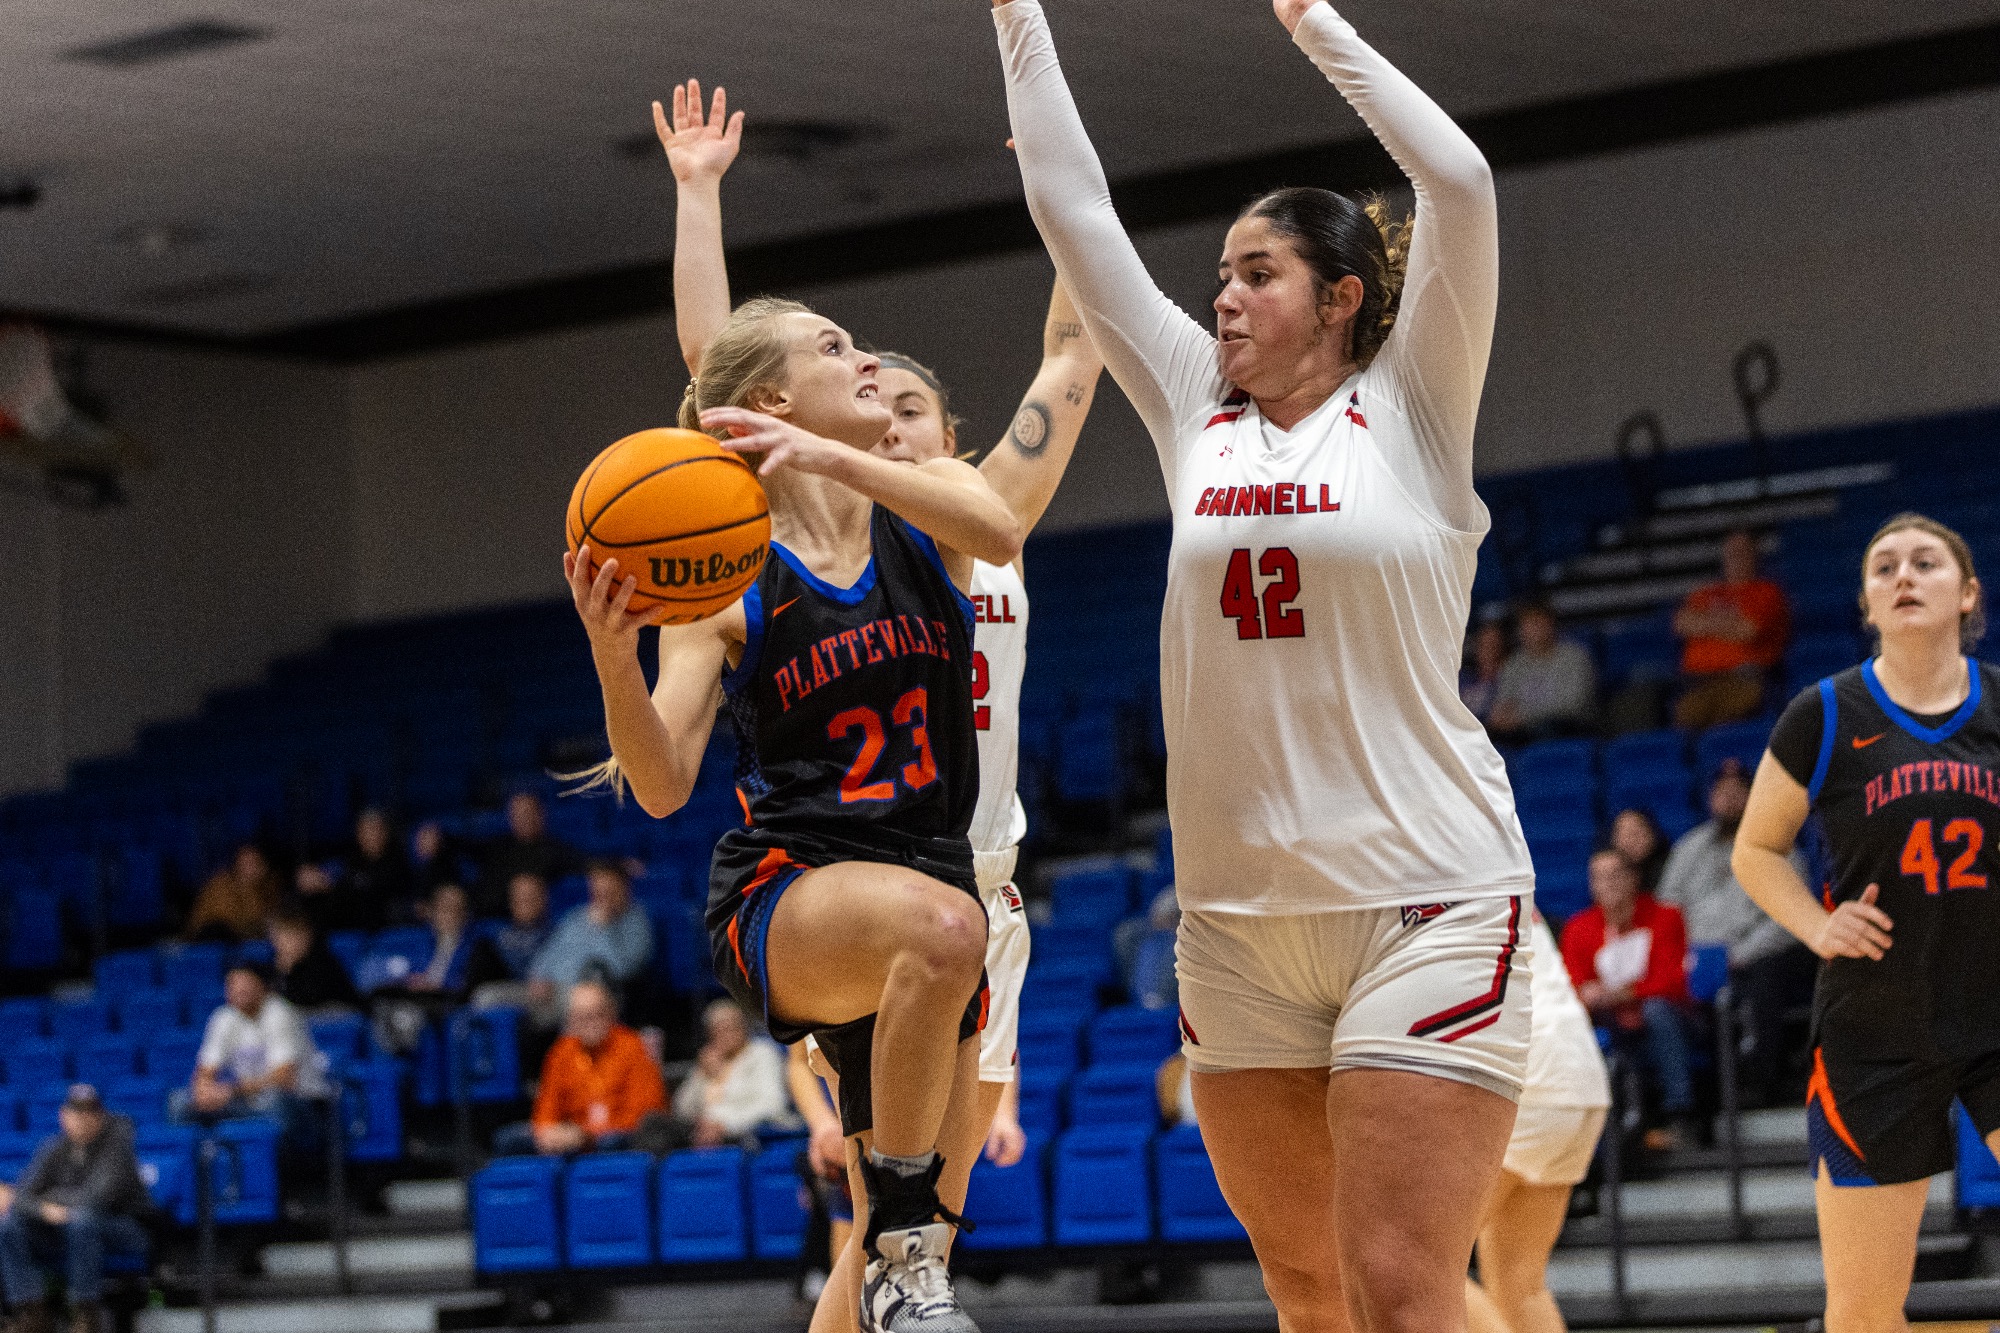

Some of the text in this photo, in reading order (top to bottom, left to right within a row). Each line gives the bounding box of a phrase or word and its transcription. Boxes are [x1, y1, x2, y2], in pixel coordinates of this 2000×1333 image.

[1194, 482, 1341, 516] GRINNELL
[648, 543, 765, 588] Wilson
[1219, 547, 1306, 640] 42
[775, 615, 951, 712] PLATTEVILLE
[826, 684, 938, 804] 23
[1865, 760, 2000, 816] PLATTEVILL
[1900, 817, 1988, 895] 42
